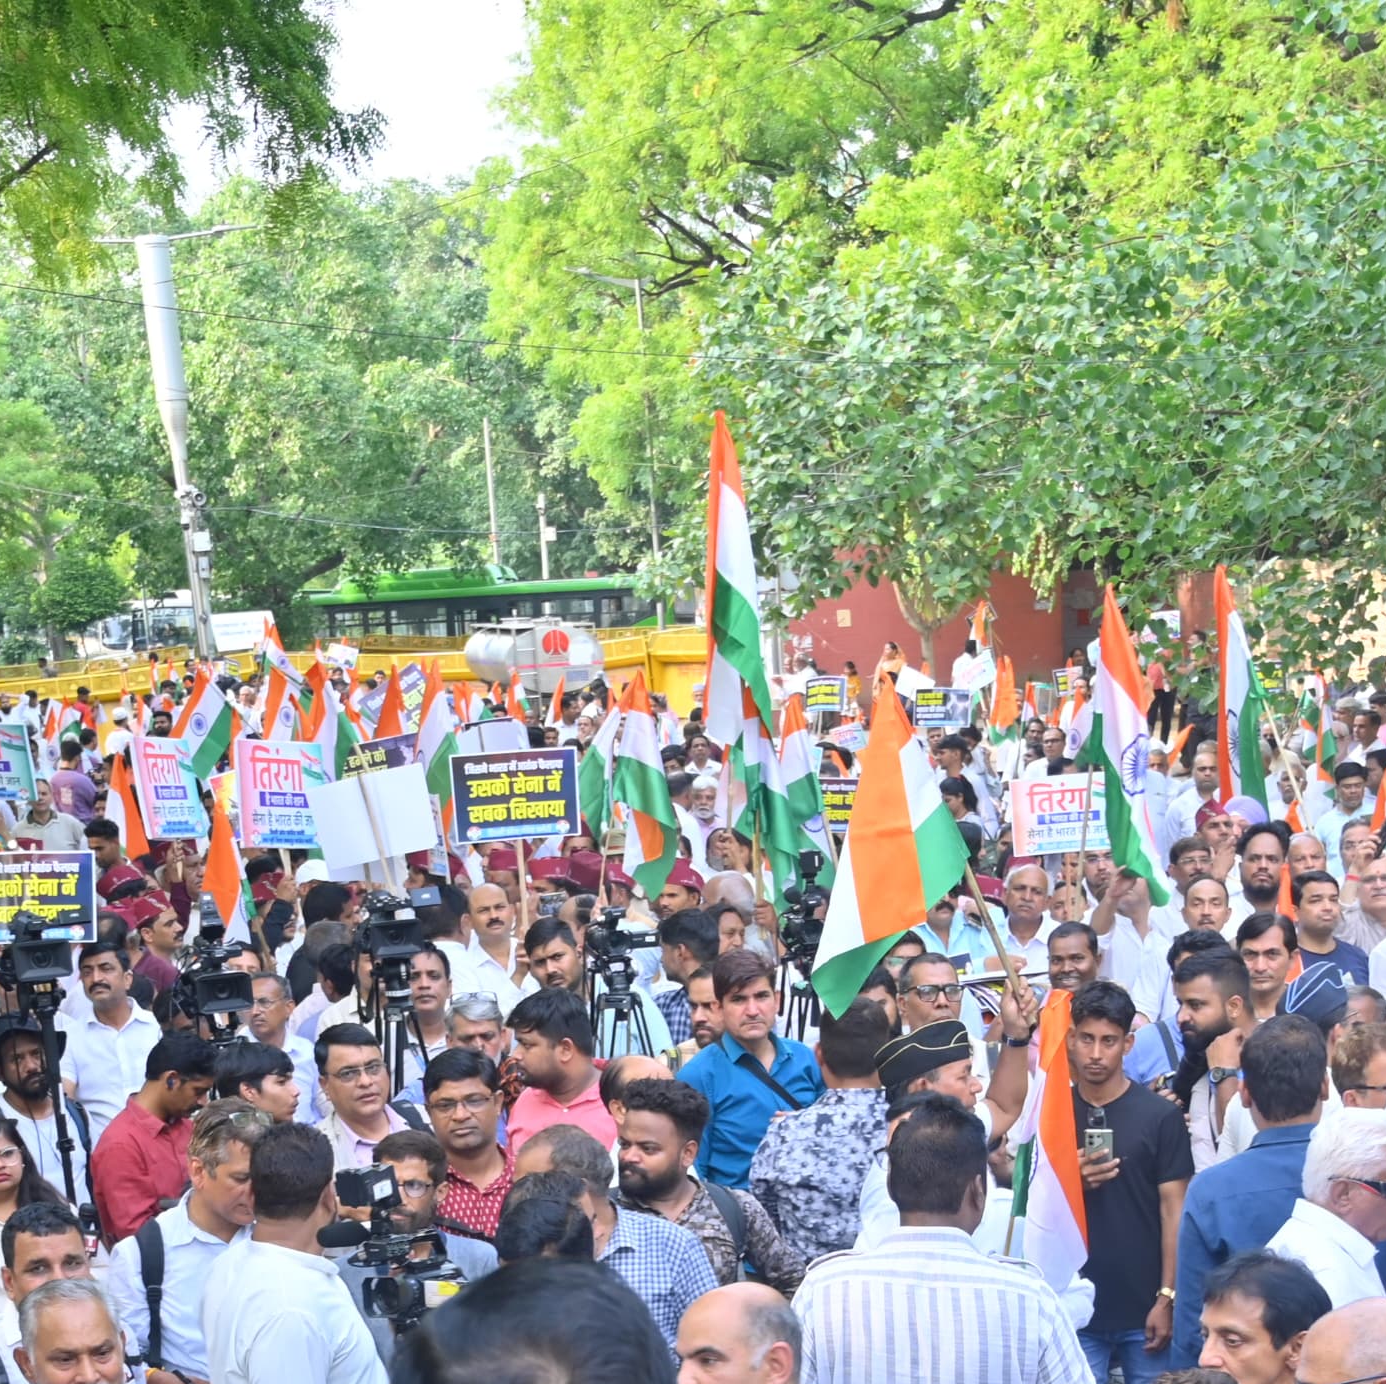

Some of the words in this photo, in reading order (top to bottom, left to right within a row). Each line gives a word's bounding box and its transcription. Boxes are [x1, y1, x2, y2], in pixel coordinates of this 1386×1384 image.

[143, 742, 181, 784] तिरंगा
[250, 745, 303, 791] तिरंगा
[466, 773, 511, 798] उसको
[511, 772, 545, 794] सेना
[467, 804, 508, 823] सबक
[508, 797, 565, 820] सिखाया
[24, 874, 59, 897] सेना
